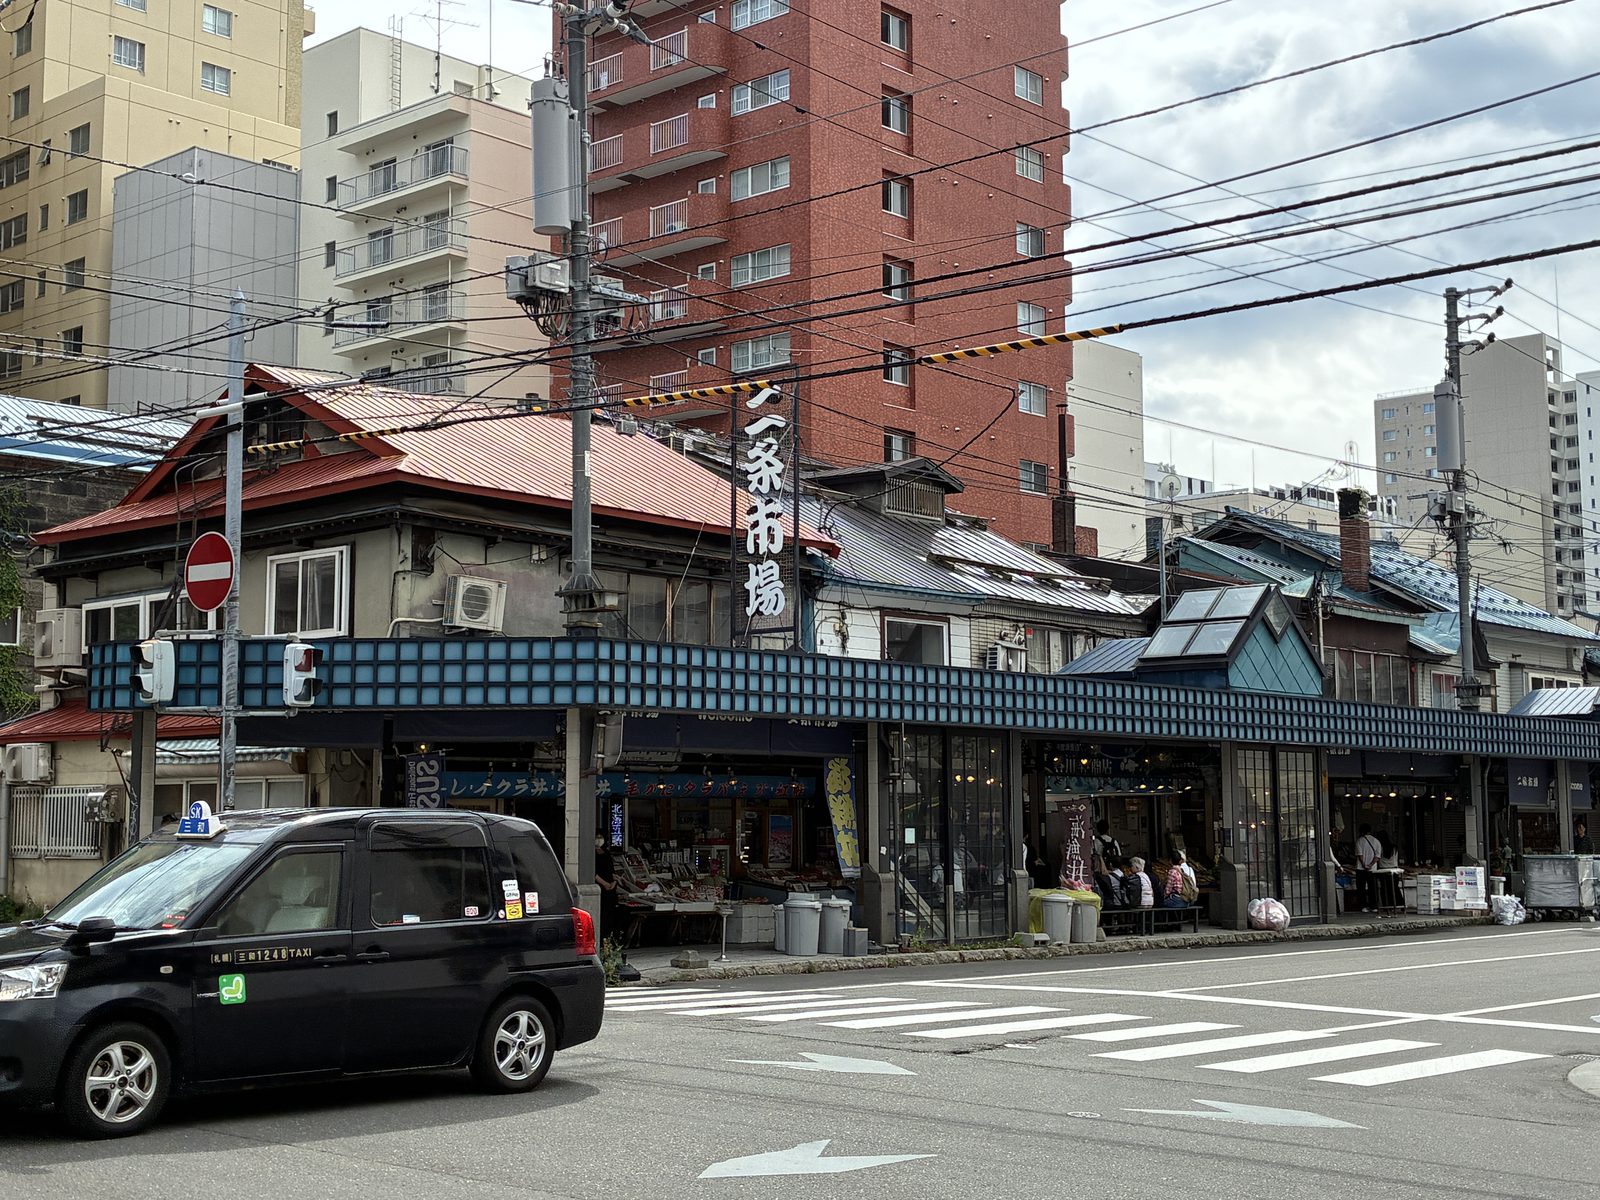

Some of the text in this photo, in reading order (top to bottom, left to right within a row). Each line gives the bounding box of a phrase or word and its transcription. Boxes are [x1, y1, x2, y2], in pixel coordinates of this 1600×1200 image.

[744, 384, 786, 617] 二条市場
[183, 821, 205, 833] 三和
[288, 948, 312, 959] TAXI
